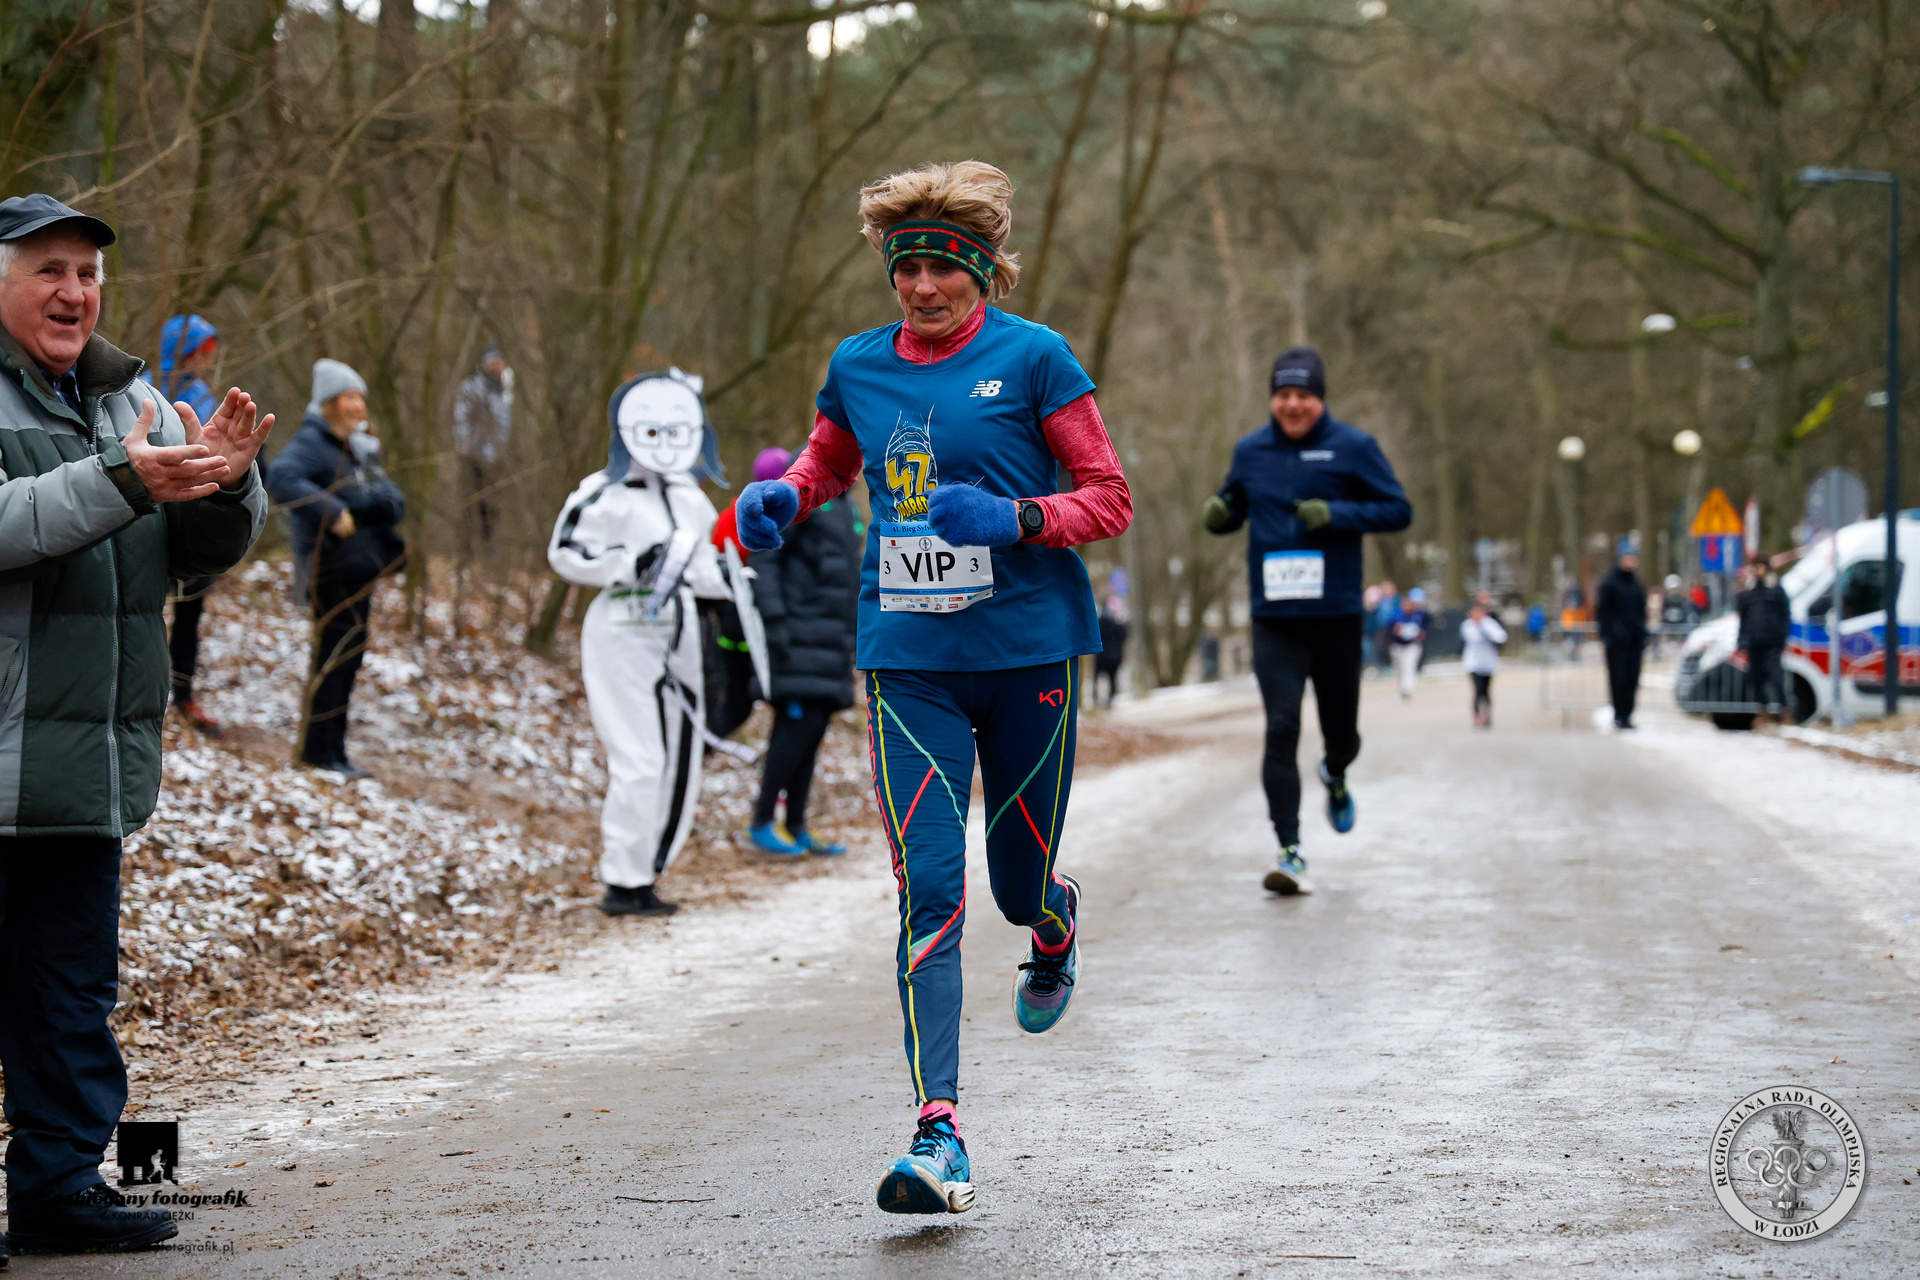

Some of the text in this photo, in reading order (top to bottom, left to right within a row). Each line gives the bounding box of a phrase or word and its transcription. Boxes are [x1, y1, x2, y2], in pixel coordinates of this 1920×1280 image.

[897, 496, 929, 517] MARAT
[884, 551, 979, 582] 3 VIP 3
